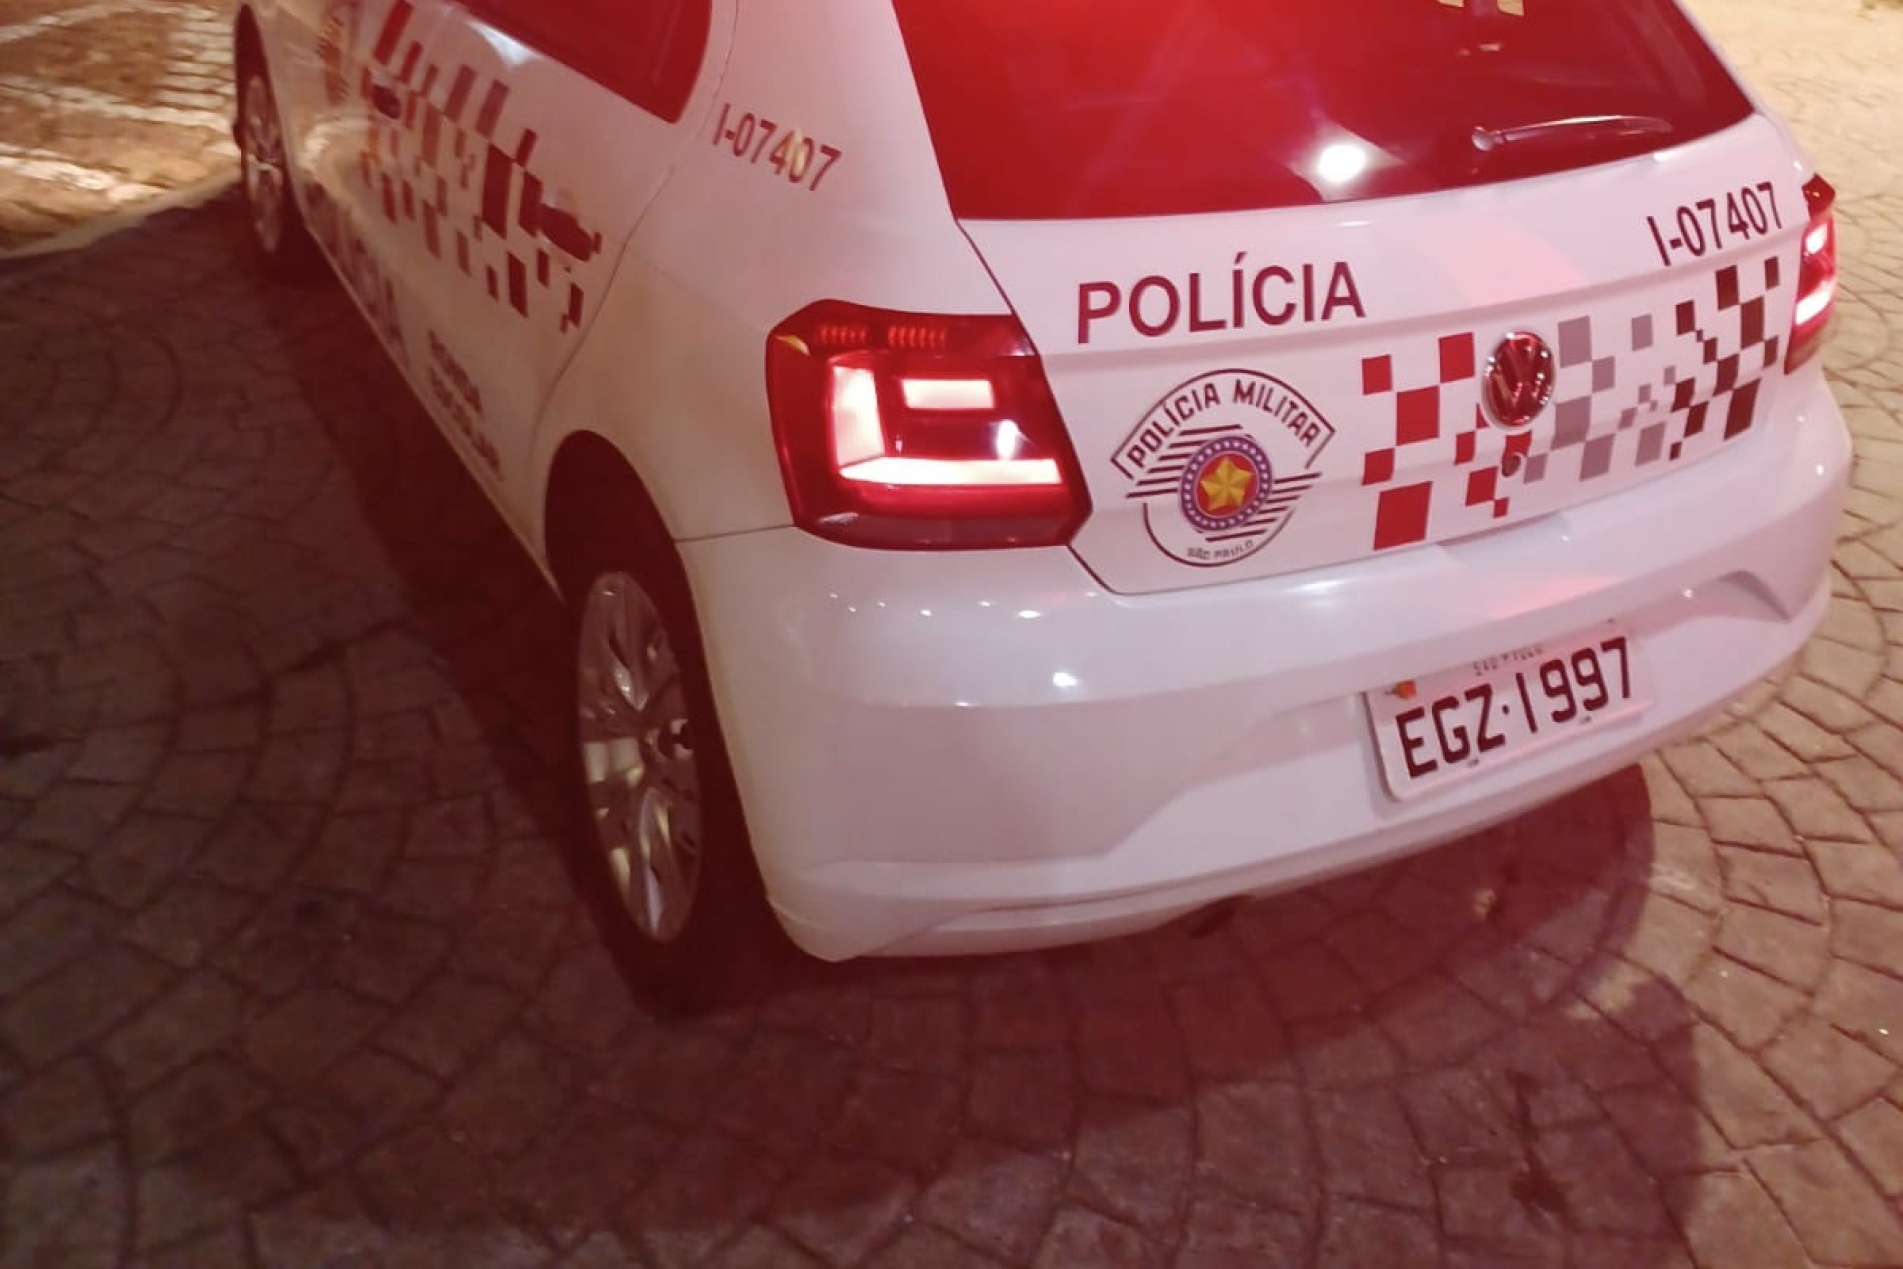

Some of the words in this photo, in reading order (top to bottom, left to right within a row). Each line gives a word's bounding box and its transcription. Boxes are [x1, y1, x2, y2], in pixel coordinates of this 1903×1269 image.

[712, 103, 842, 191] I-07407
[1647, 181, 1782, 266] I-07407
[1077, 251, 1367, 344] POLÍCIA
[1233, 379, 1321, 447] MILITAR
